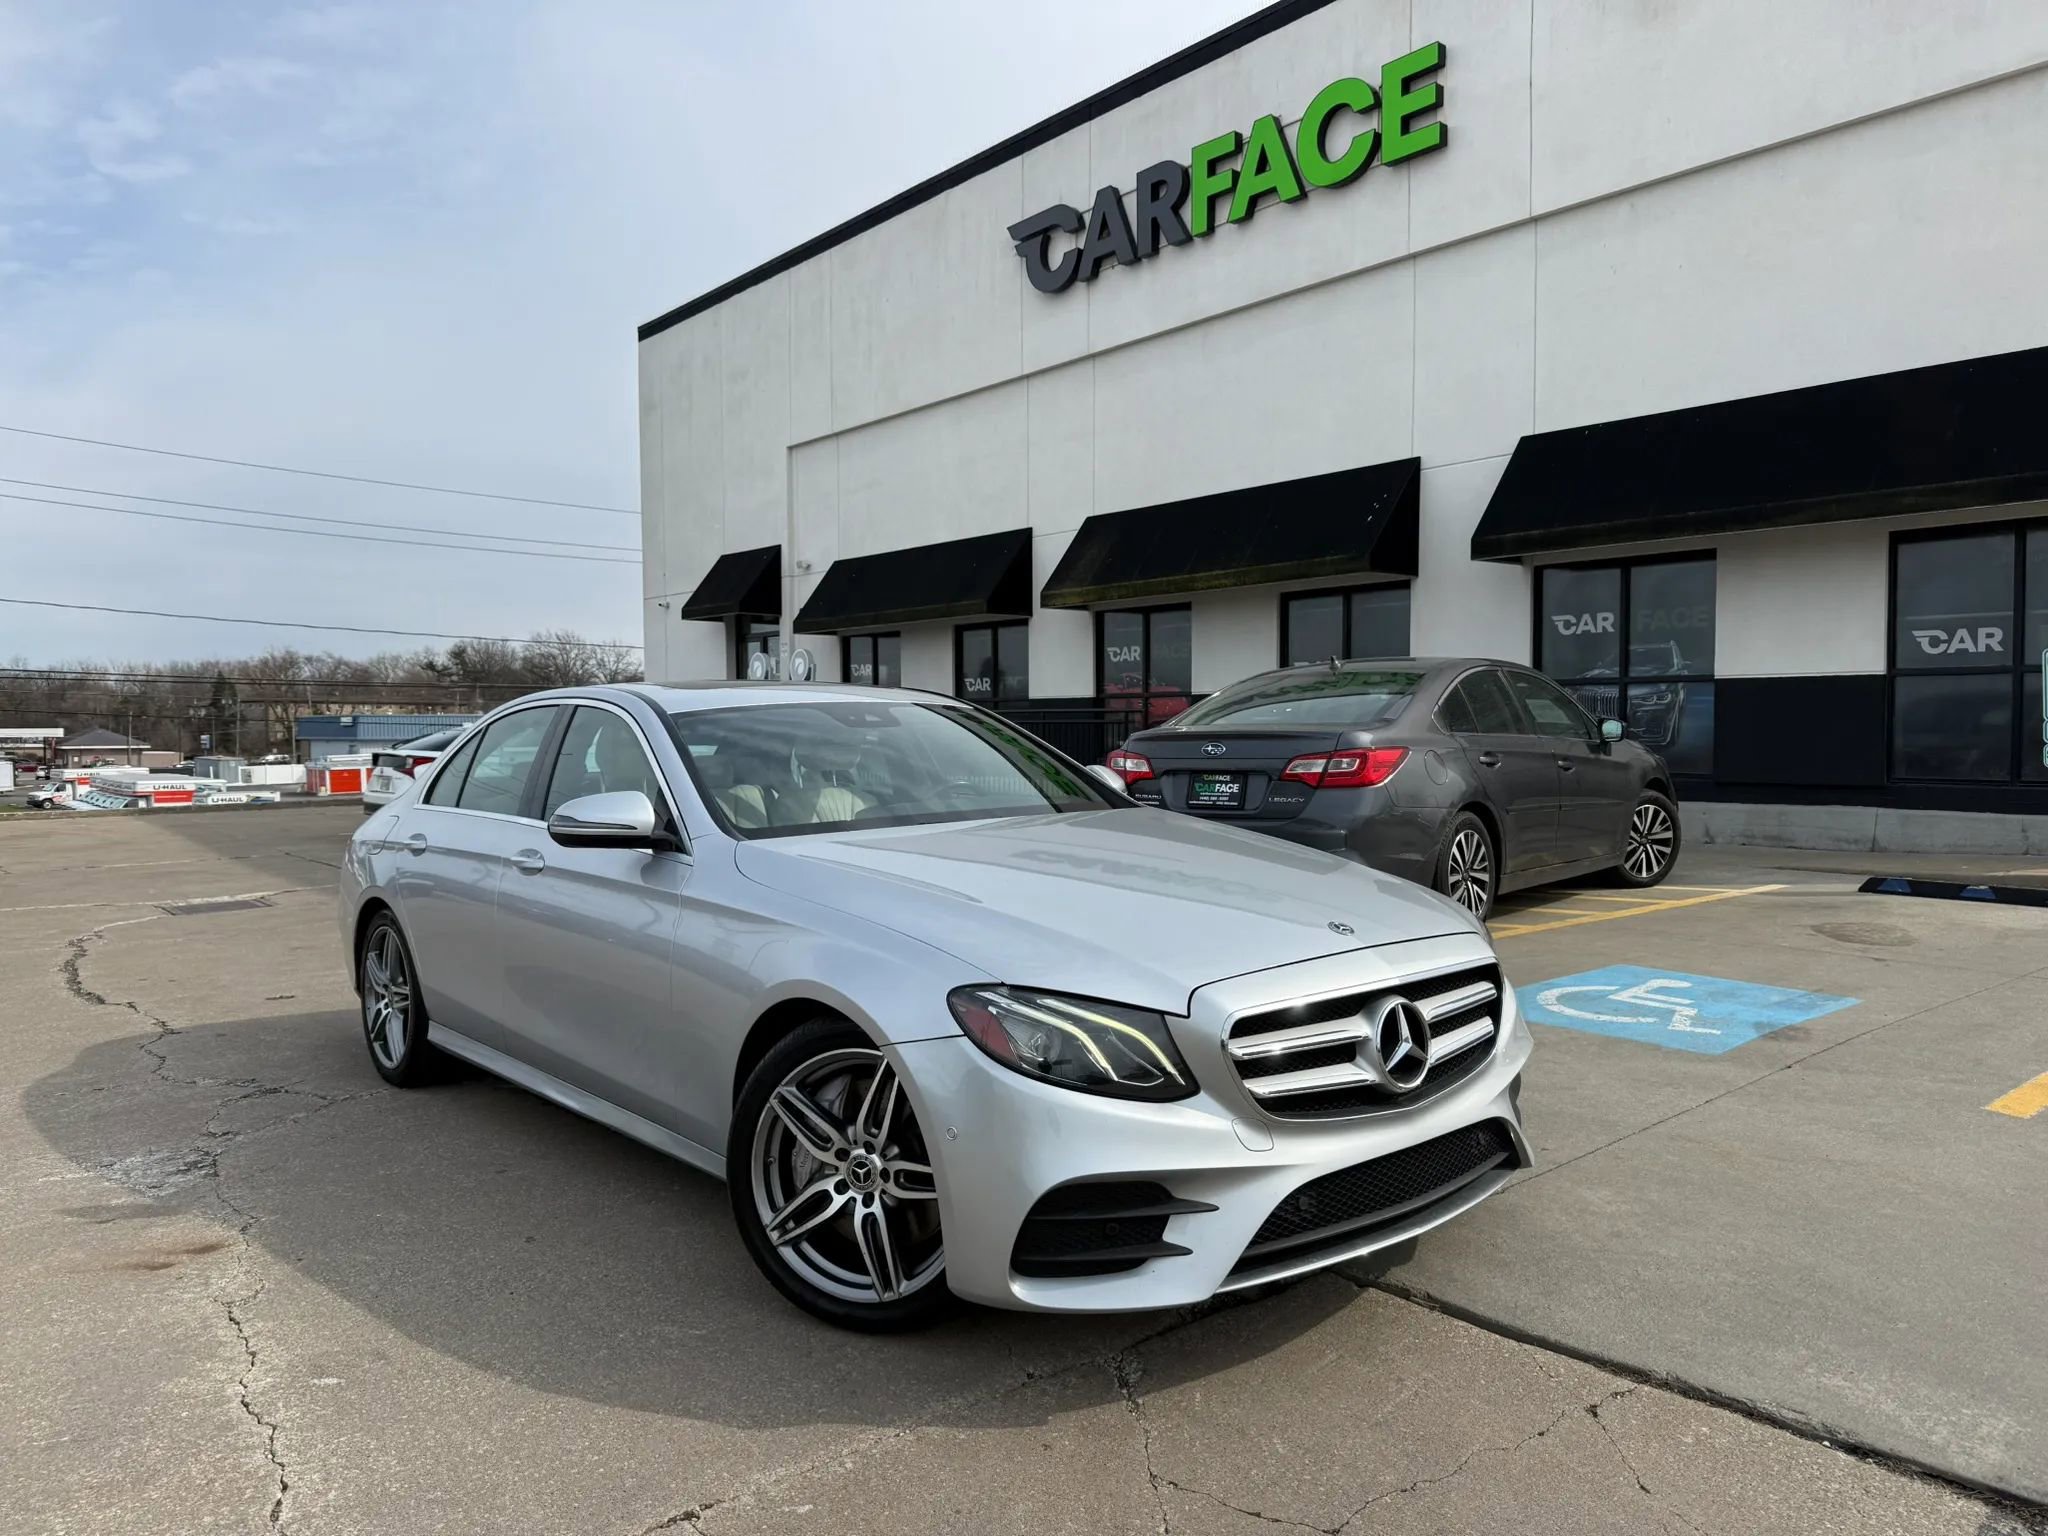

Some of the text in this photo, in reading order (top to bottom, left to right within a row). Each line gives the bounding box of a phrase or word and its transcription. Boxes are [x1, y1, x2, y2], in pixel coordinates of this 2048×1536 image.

[1007, 41, 1448, 293] CARFACE
[1551, 605, 1711, 636] CAR FACE
[1911, 626, 2004, 655] CAR
[1106, 645, 1141, 663] CAR
[850, 663, 872, 676] CAR
[964, 677, 991, 691] CAR
[1194, 783, 1240, 792] CARFACE
